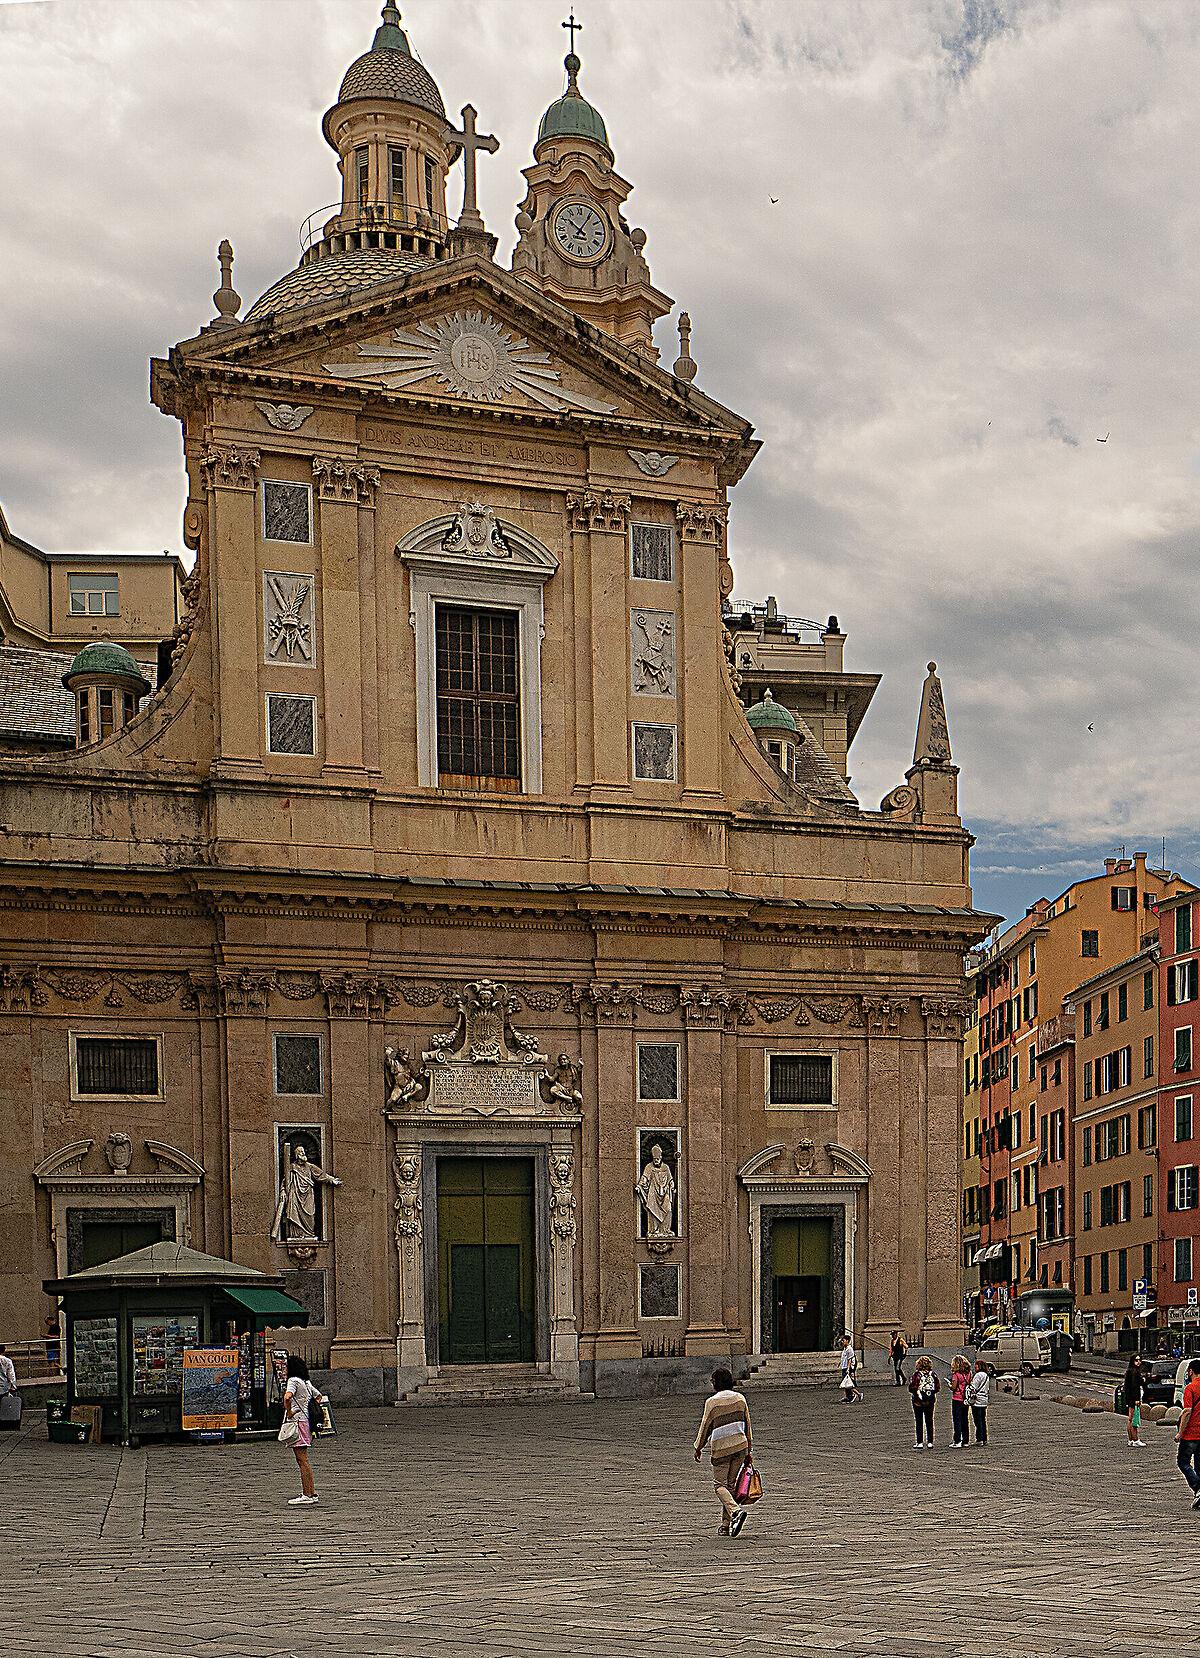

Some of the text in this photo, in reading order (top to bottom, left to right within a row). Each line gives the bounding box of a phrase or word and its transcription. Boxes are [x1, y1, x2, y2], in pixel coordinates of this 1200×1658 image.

[460, 347, 490, 372] IHS
[406, 433, 475, 455] ANDREAE
[480, 442, 500, 458] ET
[505, 446, 578, 467] AMBROSIO
[1135, 1280, 1145, 1294] P
[187, 1354, 235, 1364] VAN GOGH
